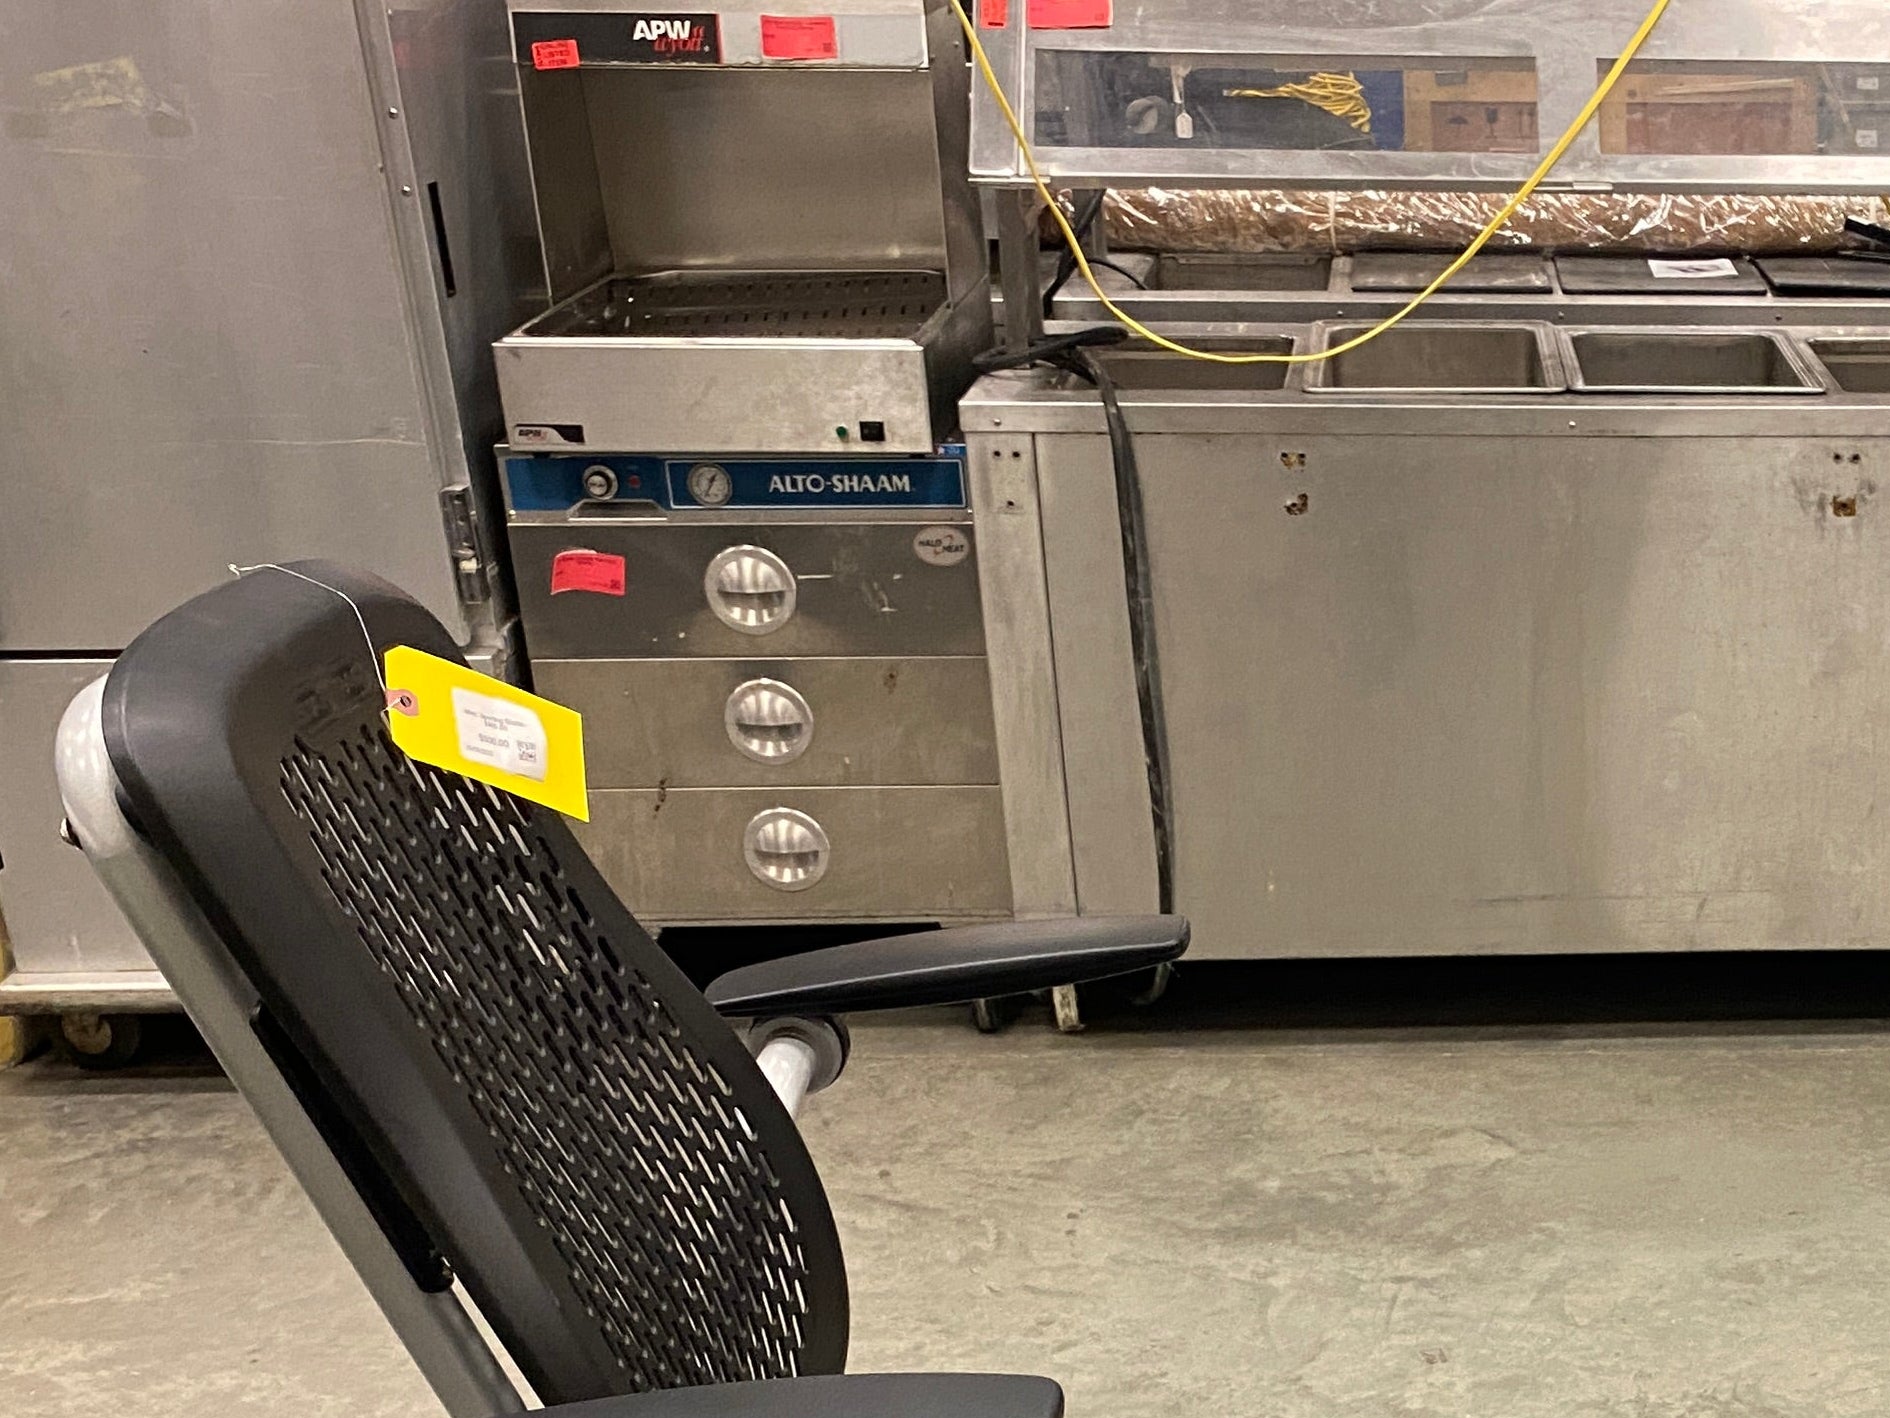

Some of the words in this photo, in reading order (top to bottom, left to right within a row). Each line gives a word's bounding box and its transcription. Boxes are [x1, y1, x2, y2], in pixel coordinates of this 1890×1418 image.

[633, 20, 691, 40] APW
[769, 474, 911, 493] ALTO-SHAAM
[918, 539, 943, 548] HALO
